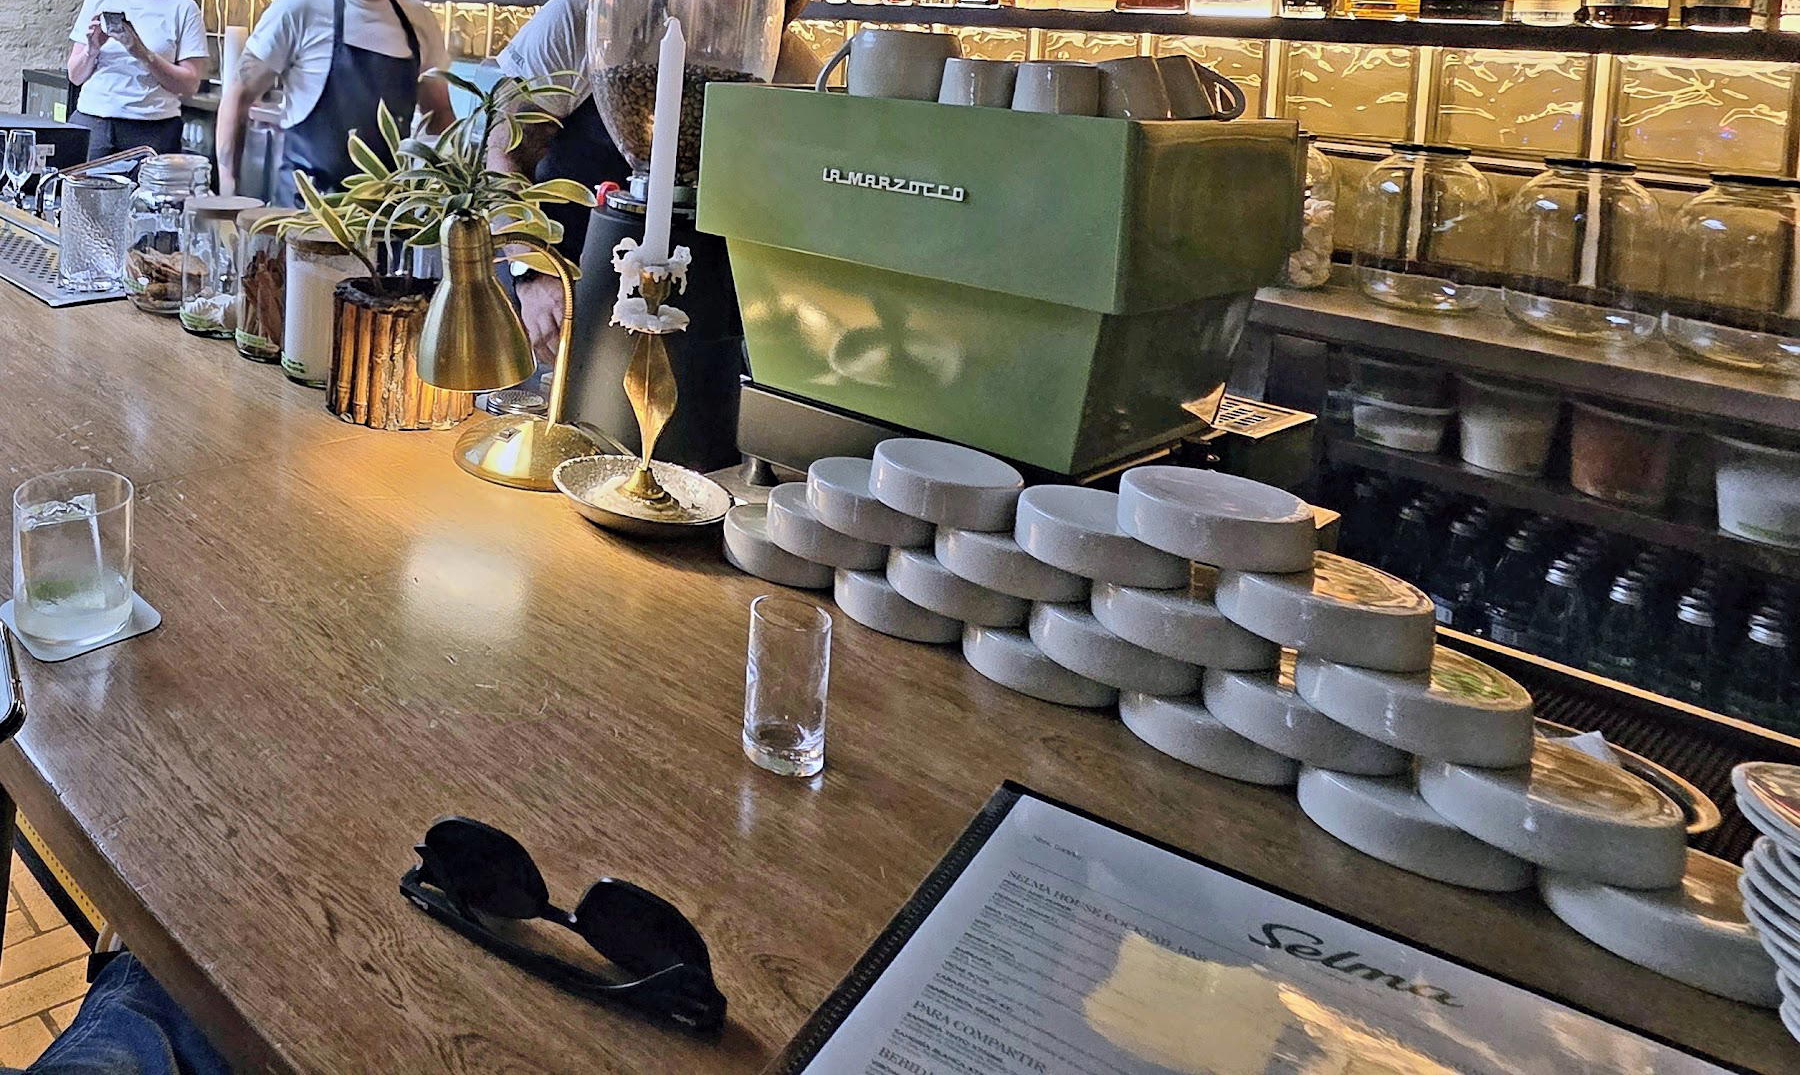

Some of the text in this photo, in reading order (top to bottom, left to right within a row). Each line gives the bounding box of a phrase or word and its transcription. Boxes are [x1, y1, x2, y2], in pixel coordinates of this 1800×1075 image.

[848, 171, 964, 202] MARZOCCO
[1008, 869, 1051, 895] SELMA
[1053, 891, 1102, 918] HOUSE
[1248, 922, 1463, 1008] Selma
[912, 1000, 950, 1025] PARA
[953, 1020, 1047, 1073] COMPARTIR
